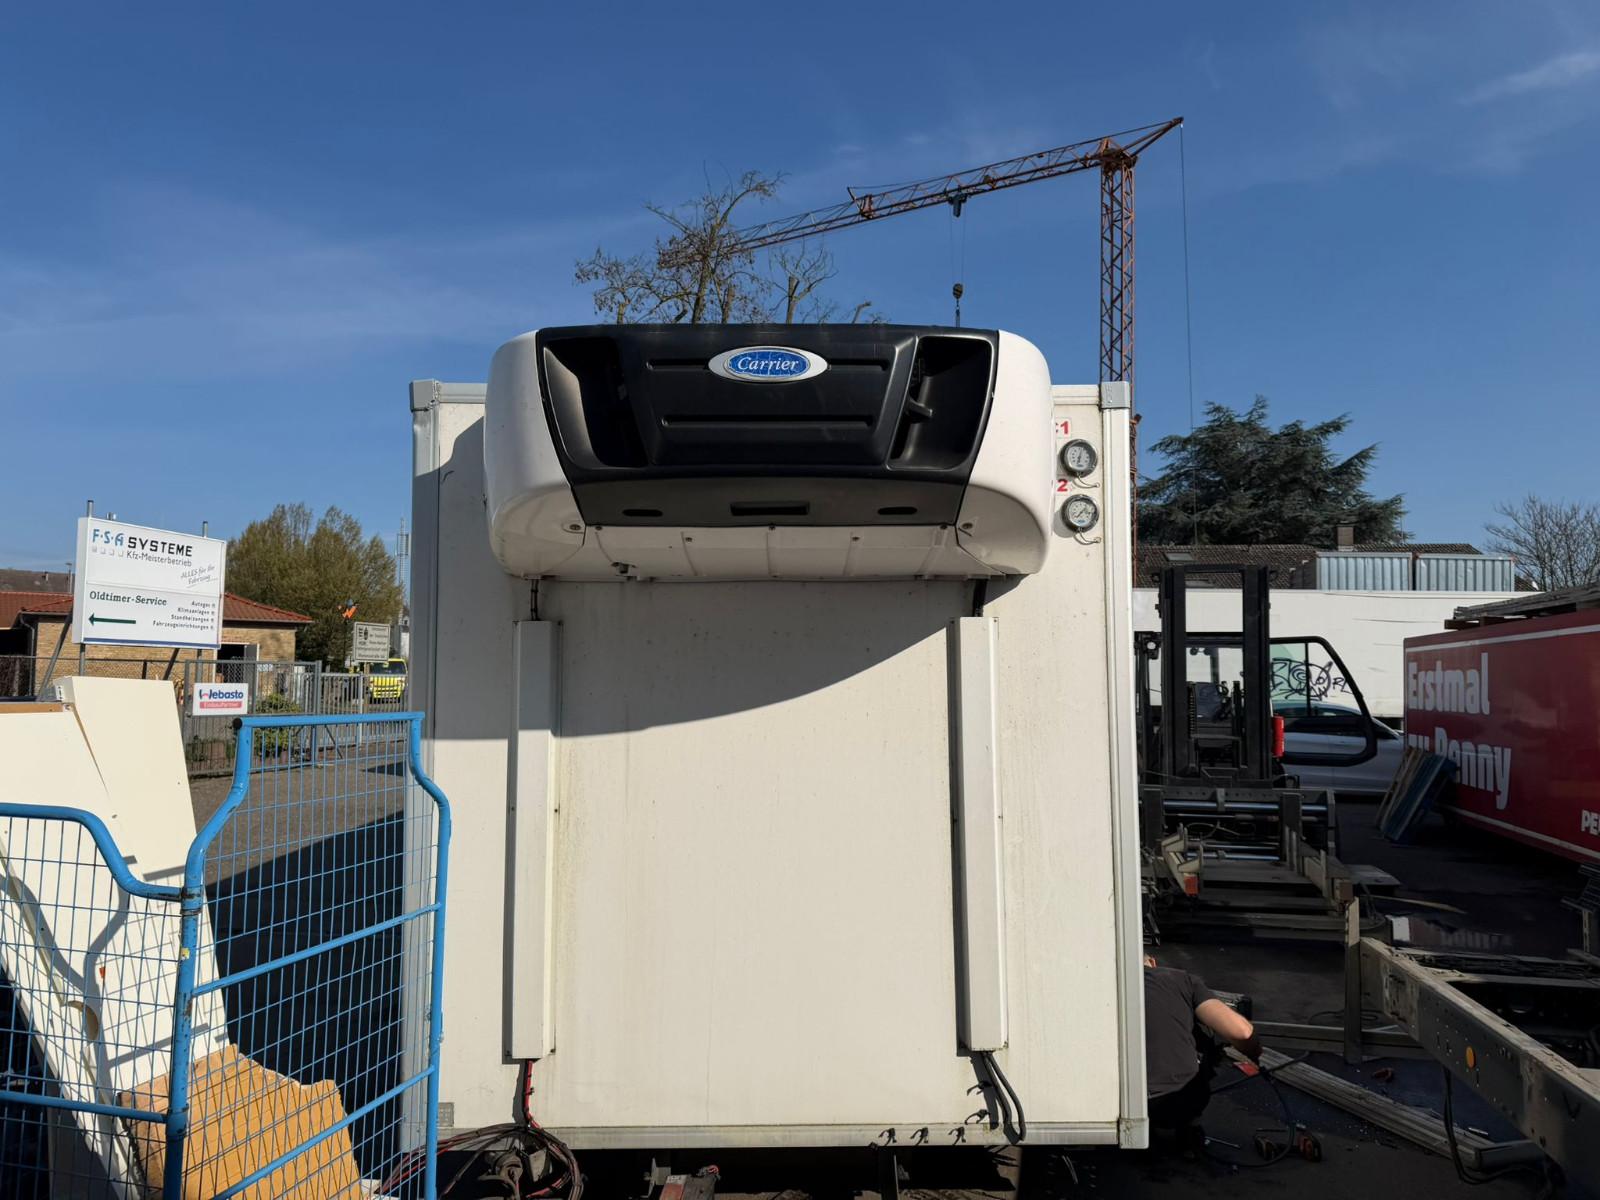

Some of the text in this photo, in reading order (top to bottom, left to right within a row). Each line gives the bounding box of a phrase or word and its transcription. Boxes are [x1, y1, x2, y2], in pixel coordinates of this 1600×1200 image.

[737, 357, 799, 370] Carrier
[1056, 421, 1069, 435] 1
[1057, 479, 1068, 492] 2
[127, 536, 193, 557] SYSTEME
[126, 550, 192, 567] Kfz-Meisterbetrieb
[89, 590, 168, 606] Oldtimer-Service
[170, 614, 209, 623] Standheizungen
[177, 607, 210, 616] Klimaanlagen
[1408, 652, 1490, 715] Erstmal
[199, 689, 244, 700] Webasto
[1581, 809, 1600, 836] PE
